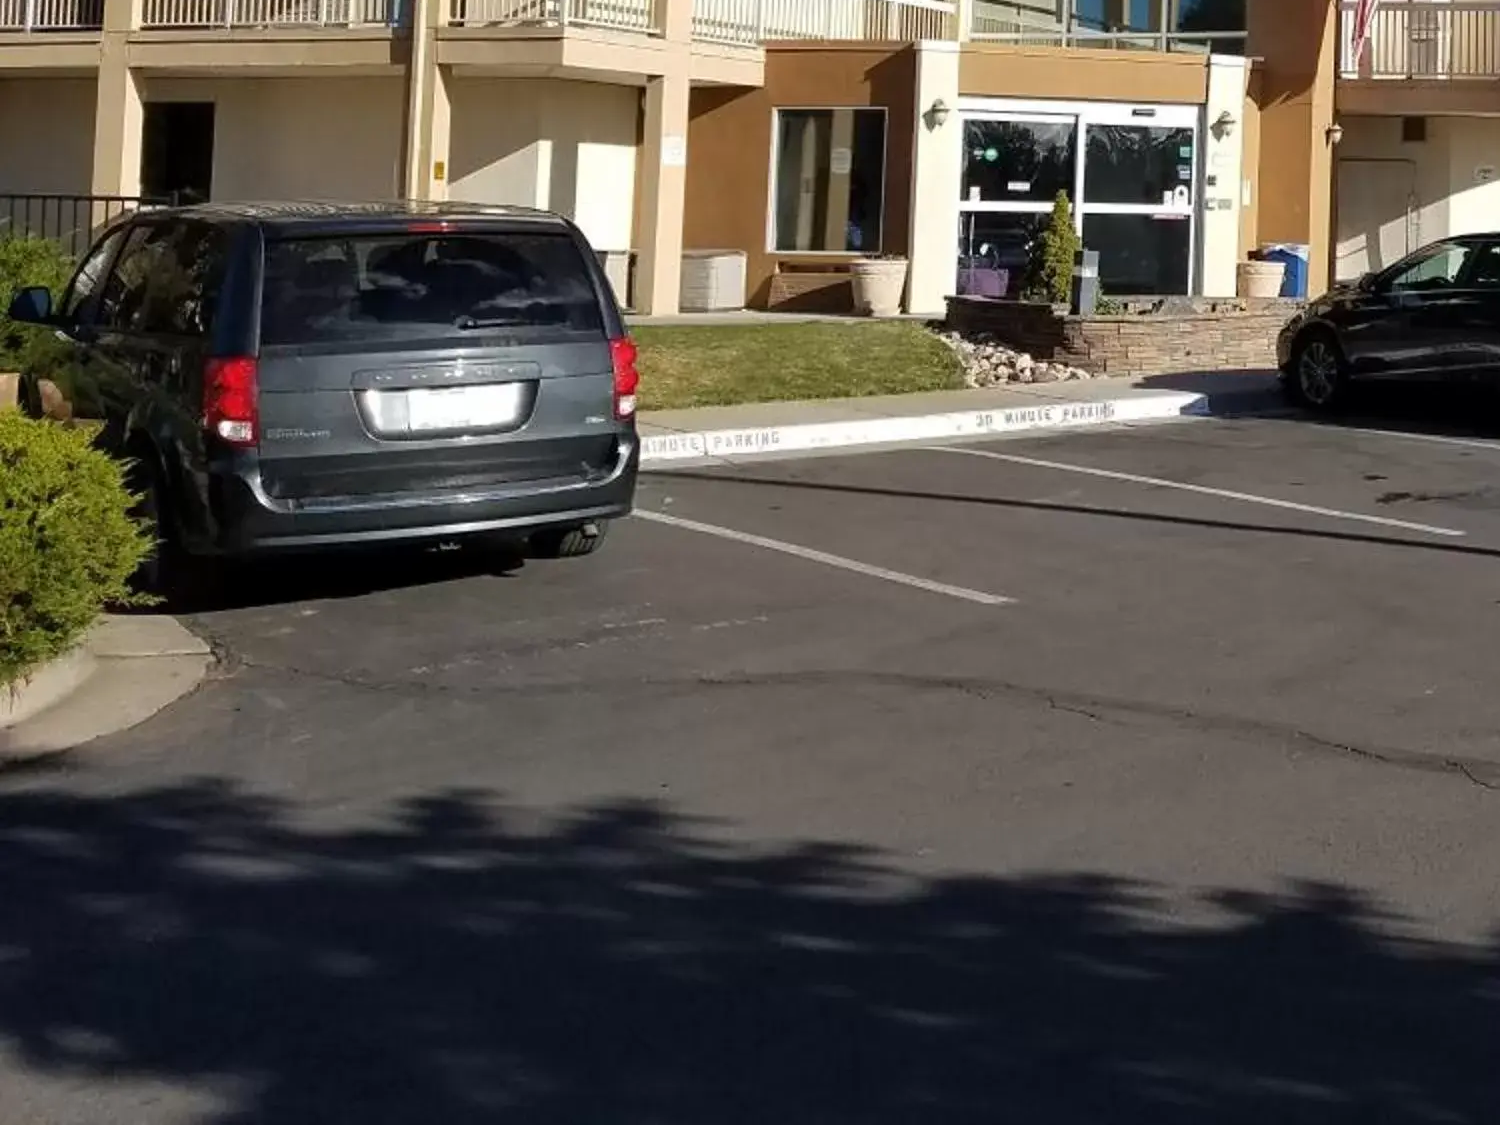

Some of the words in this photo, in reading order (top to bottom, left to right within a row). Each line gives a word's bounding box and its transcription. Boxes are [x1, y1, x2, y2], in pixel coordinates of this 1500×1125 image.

[1004, 408, 1053, 424] MINUTE
[1063, 402, 1116, 422] PARKING
[713, 431, 781, 449] PARKING
